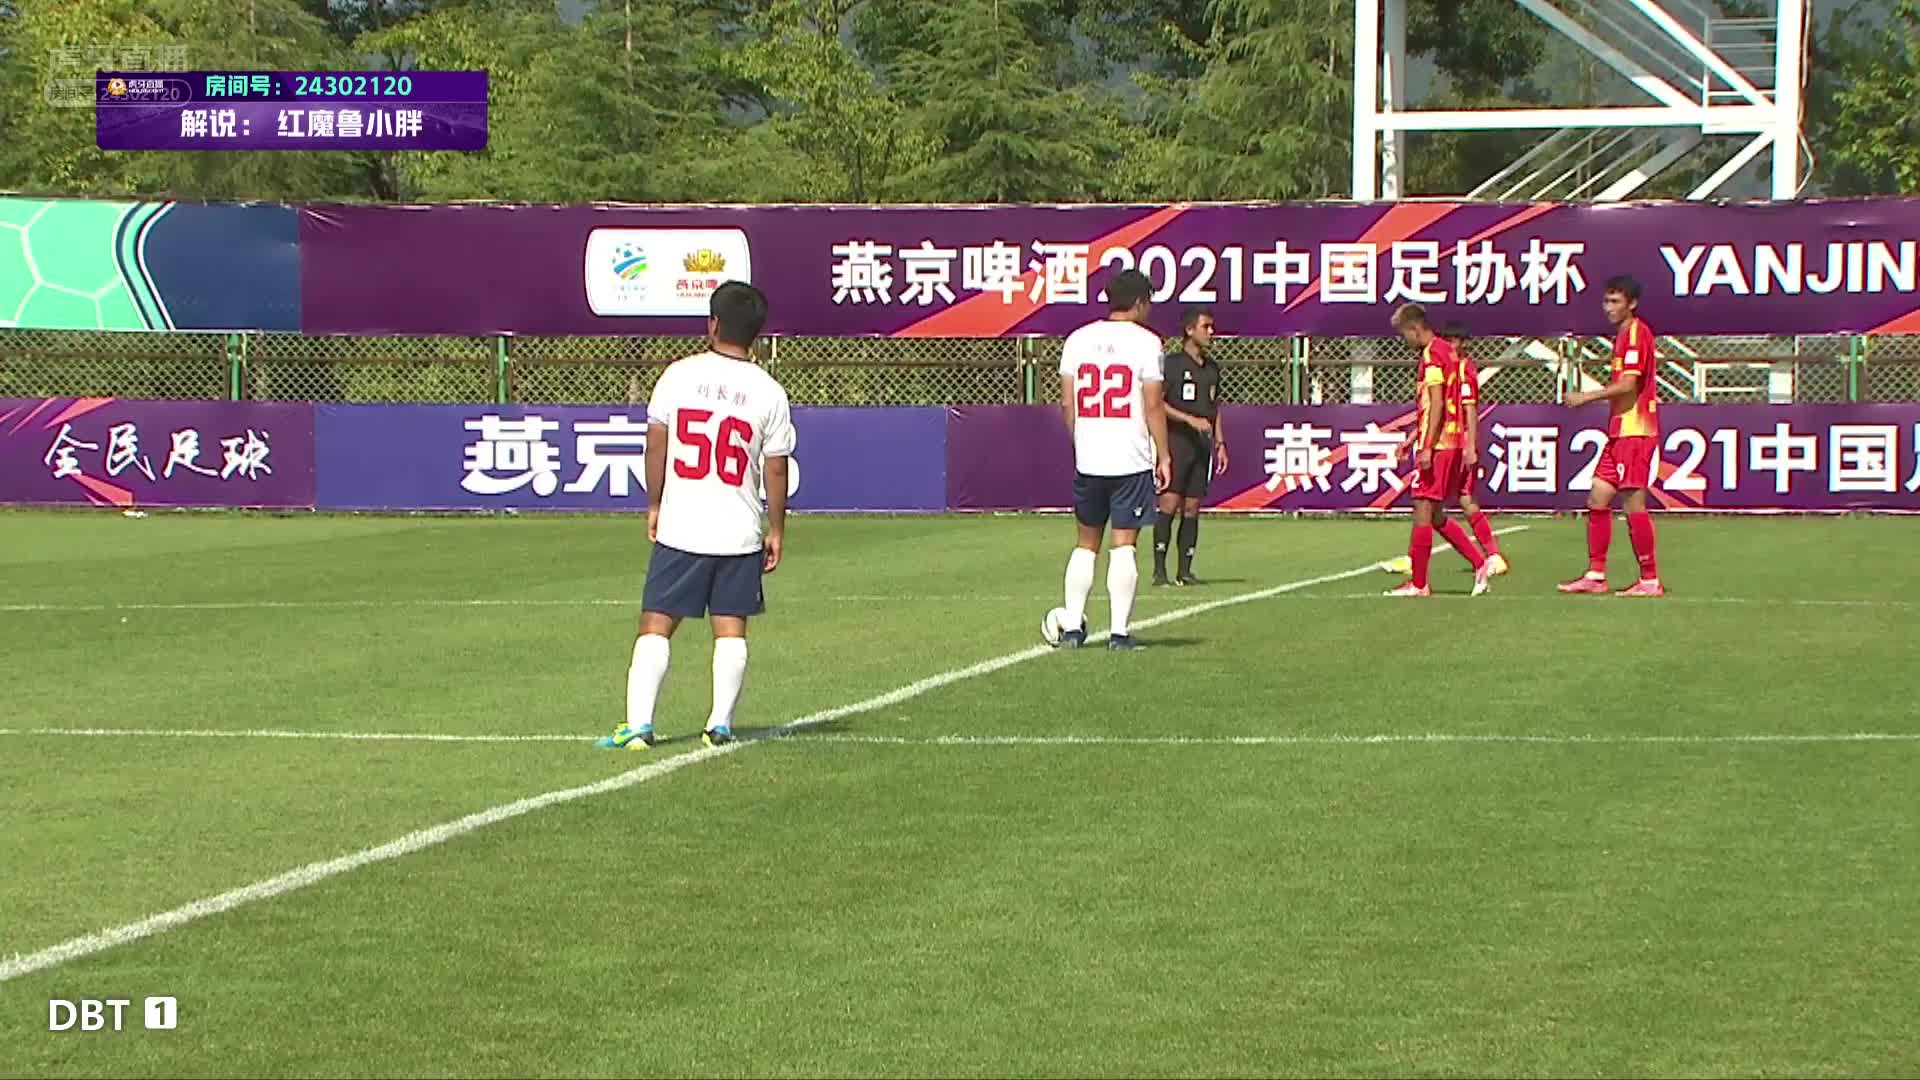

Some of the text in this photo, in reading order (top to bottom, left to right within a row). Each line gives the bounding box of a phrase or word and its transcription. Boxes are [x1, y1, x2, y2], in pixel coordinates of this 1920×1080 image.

[1659, 240, 1917, 298] YANJIN
[1077, 363, 1133, 419] 22
[44, 423, 272, 481] 全民足球
[673, 408, 754, 487] 56
